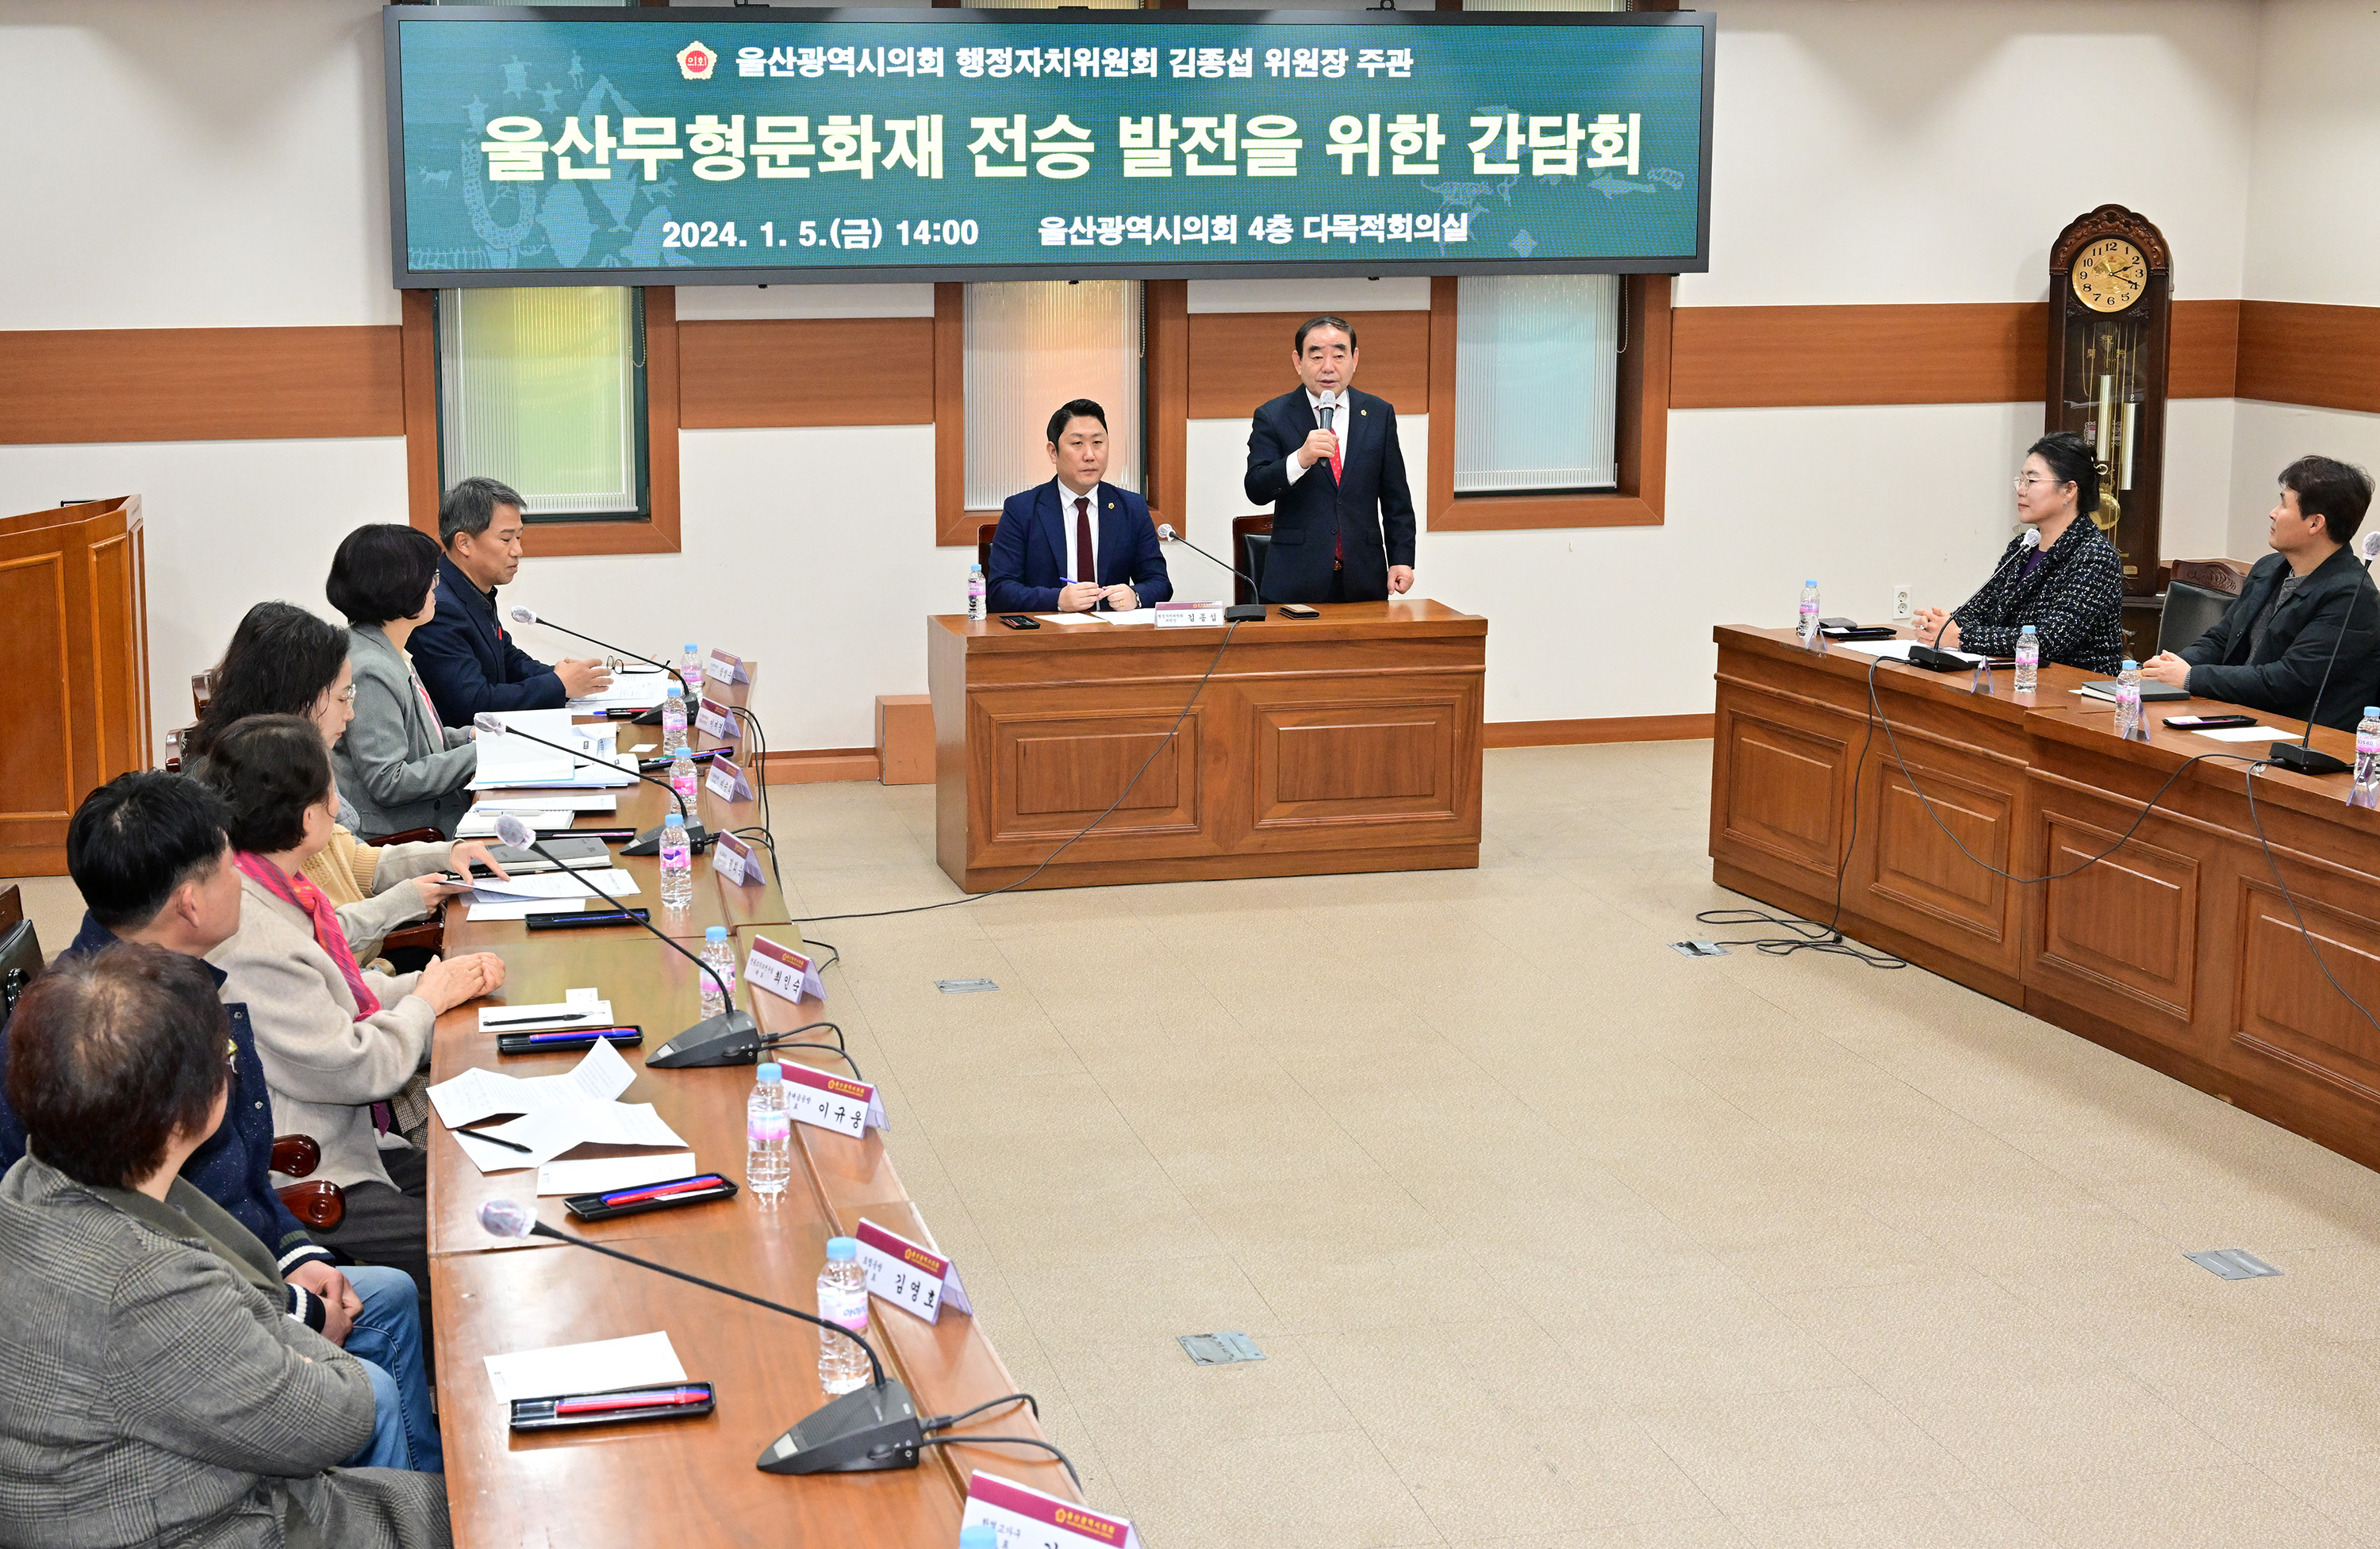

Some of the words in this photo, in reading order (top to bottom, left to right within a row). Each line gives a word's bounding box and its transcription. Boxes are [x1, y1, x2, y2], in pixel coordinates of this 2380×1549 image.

[687, 56, 707, 67] 의회
[735, 46, 944, 78] 울산광역시의회
[955, 47, 1157, 78] 행정자치위원회
[1169, 47, 1253, 79] 김종섭
[1264, 48, 1349, 79] 위원장
[1357, 48, 1414, 78] 주관
[481, 114, 943, 182] 울산무형문화재
[966, 113, 1095, 179] 전승
[1119, 113, 1303, 178] 발전을
[1326, 113, 1445, 177] 위한
[1467, 113, 1641, 176] 간담회
[662, 220, 747, 248] 2024.
[760, 221, 787, 247] 1.
[799, 217, 882, 250] 5.(금)
[896, 219, 979, 246] 14:00
[1038, 214, 1238, 246] 울산광역시의회
[1248, 213, 1294, 244] 4층
[1303, 213, 1468, 243] 다목적회의실
[2106, 242, 2117, 251] 12
[2125, 246, 2129, 255] 1
[2092, 247, 2102, 256] 11
[2082, 258, 2094, 267] 10
[2132, 255, 2140, 265] 2
[2079, 271, 2088, 280] 9
[2135, 269, 2144, 278] 3
[2082, 283, 2092, 292] 8
[2093, 293, 2102, 302] 7
[2106, 297, 2115, 305] 6
[2121, 292, 2130, 302] 5
[819, 1102, 862, 1129] 이규웅
[895, 1274, 935, 1309] 김영호
